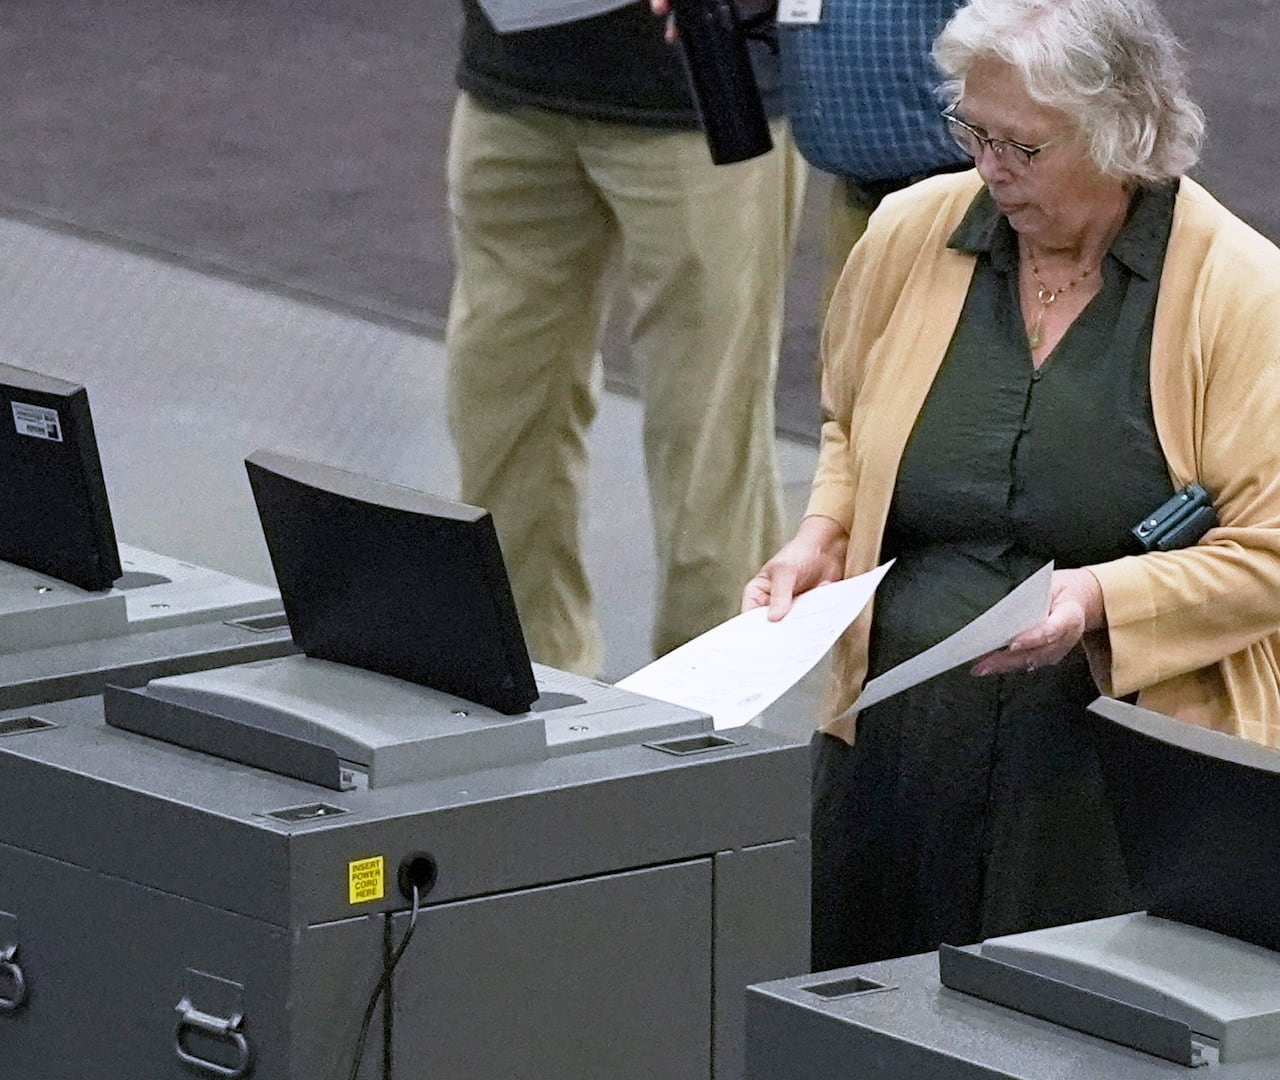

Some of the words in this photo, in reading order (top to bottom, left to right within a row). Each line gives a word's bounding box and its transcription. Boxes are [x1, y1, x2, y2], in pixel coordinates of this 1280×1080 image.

[352, 860, 380, 872] INSERT
[352, 870, 380, 881] POWER
[355, 879, 377, 890] CORD
[356, 887, 377, 900] HERE
